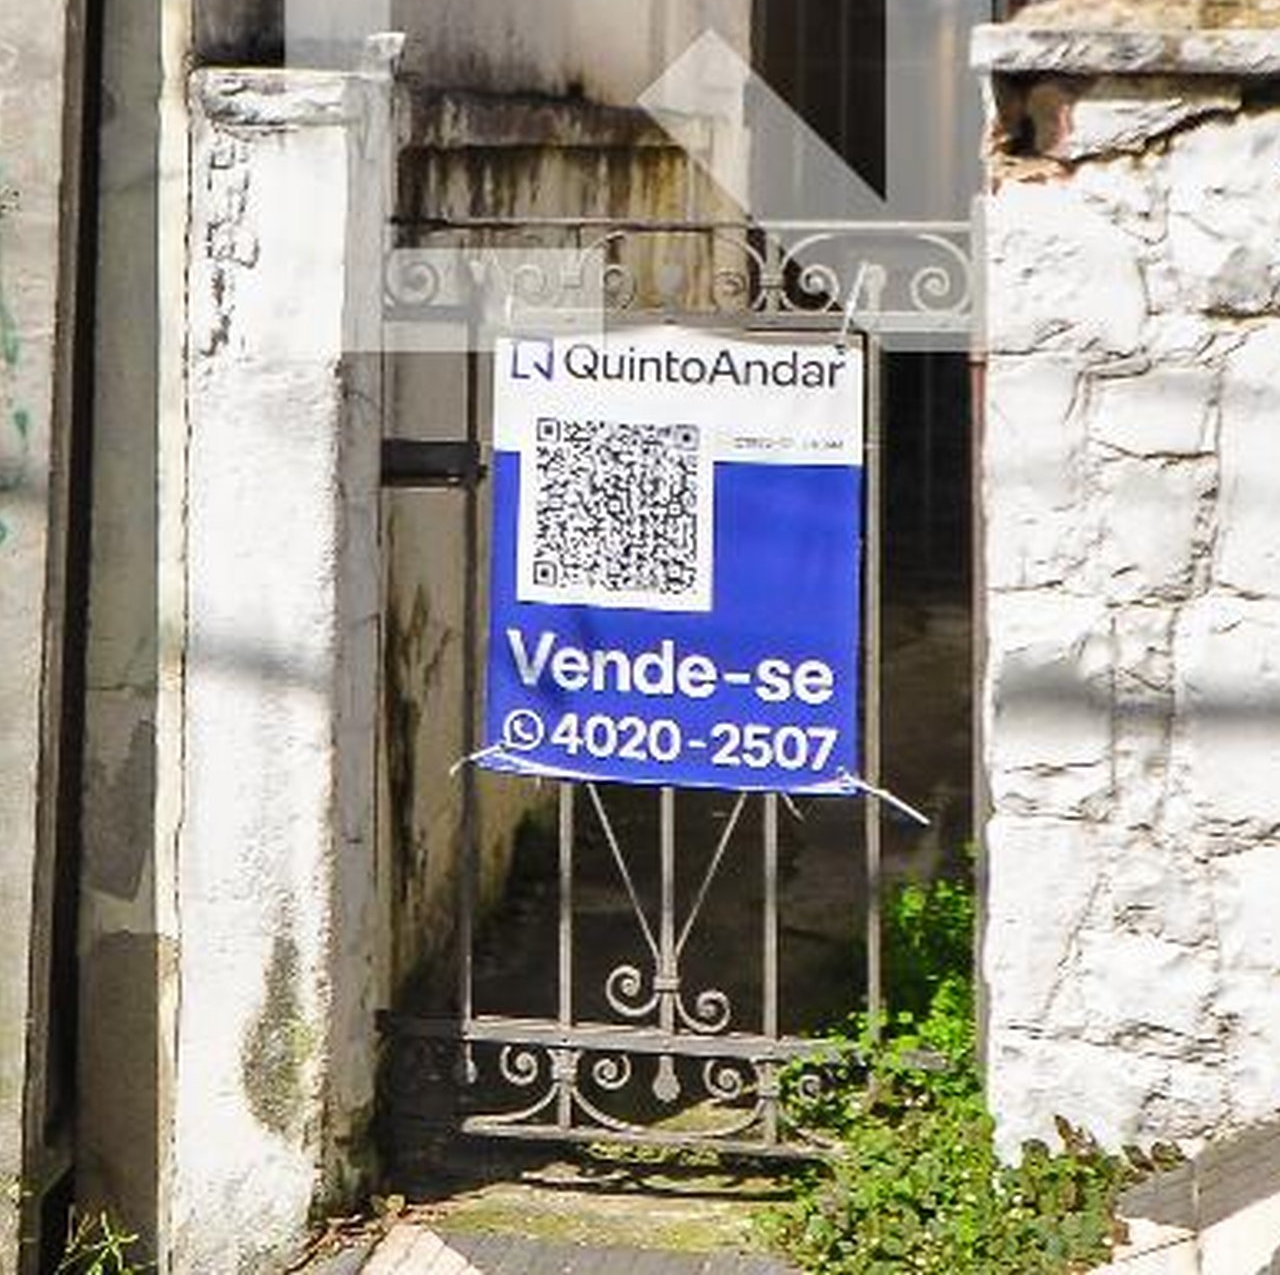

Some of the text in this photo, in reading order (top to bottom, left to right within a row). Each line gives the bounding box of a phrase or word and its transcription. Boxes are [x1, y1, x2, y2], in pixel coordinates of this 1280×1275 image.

[564, 343, 846, 388] QuintoAndar
[505, 628, 835, 705] Vende-se
[550, 712, 839, 772] 4020-2507
